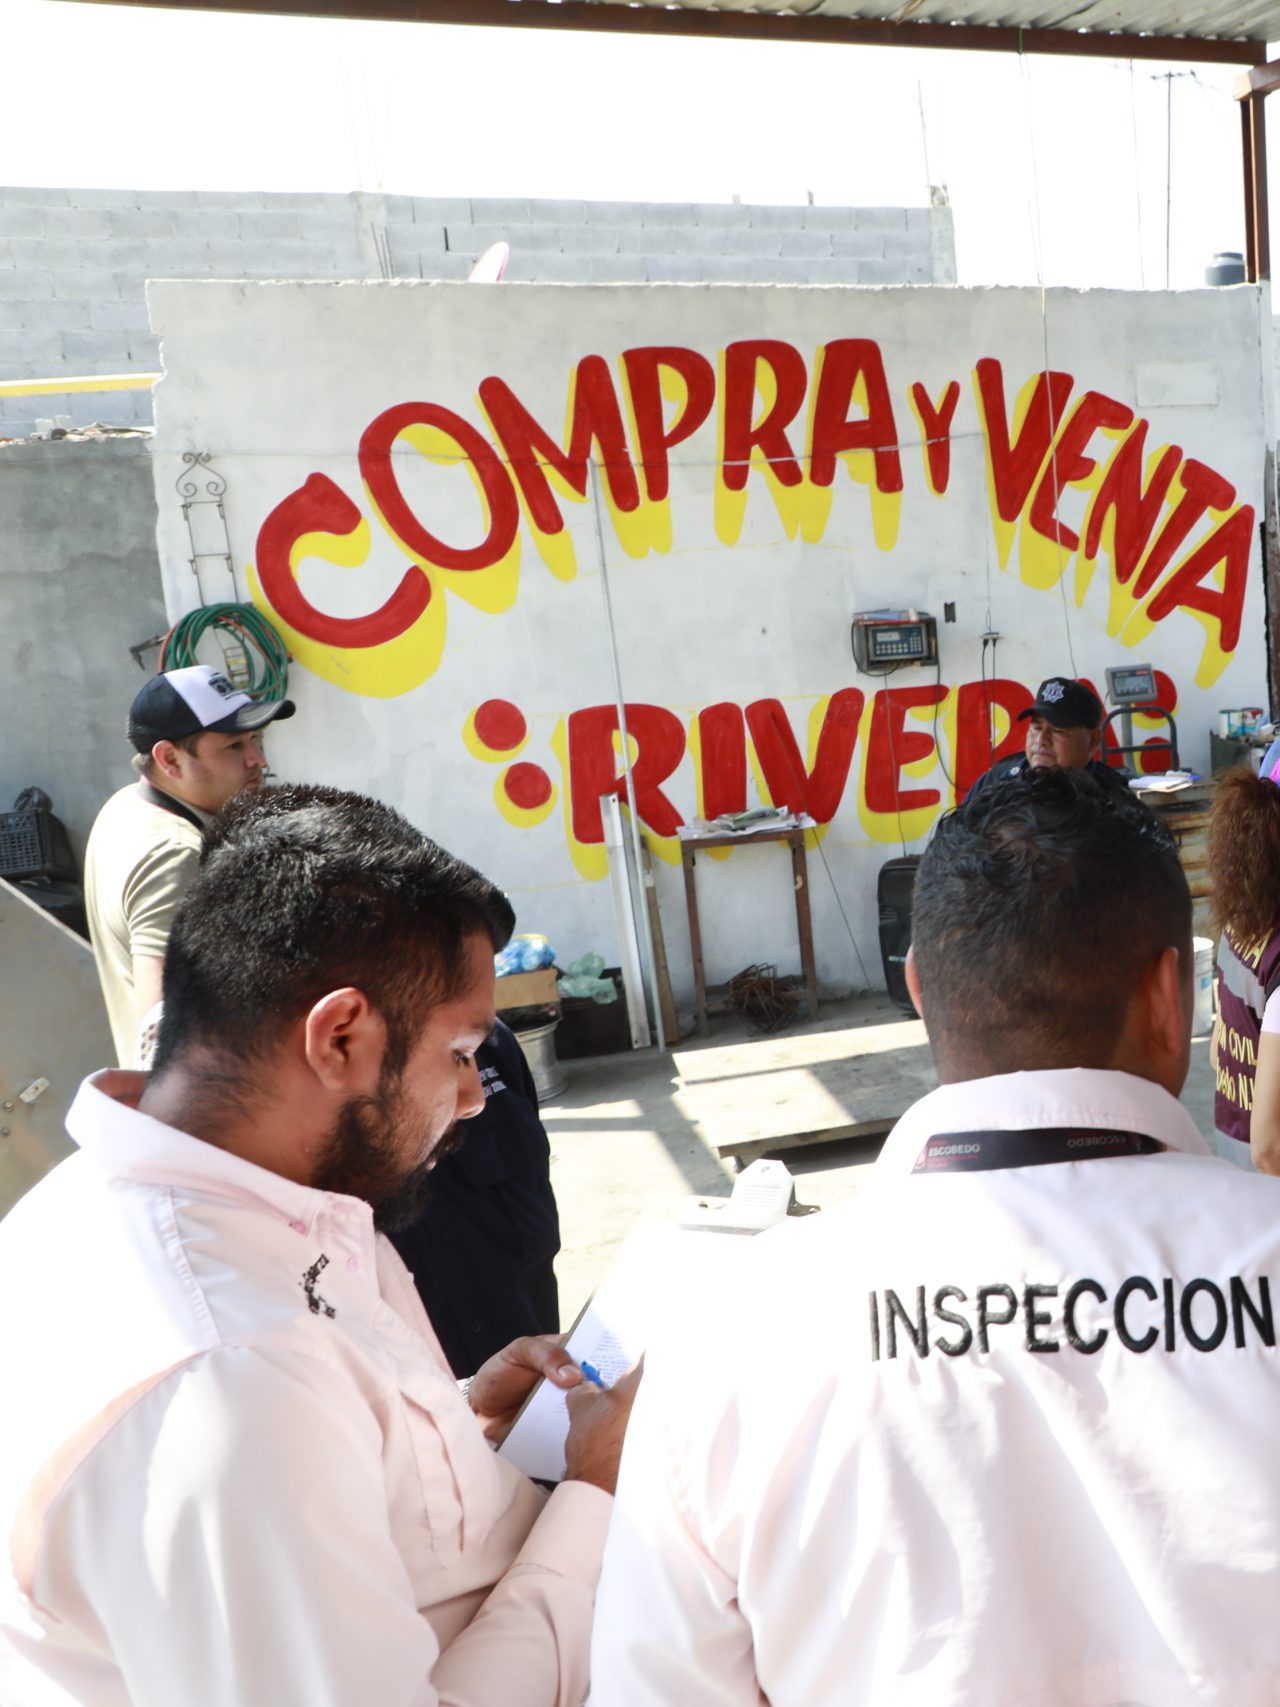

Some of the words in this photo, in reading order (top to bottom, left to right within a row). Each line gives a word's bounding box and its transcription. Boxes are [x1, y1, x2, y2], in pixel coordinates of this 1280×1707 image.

[254, 338, 903, 650] COMPRA
[911, 380, 960, 494] Y
[975, 357, 1255, 653] VENTA
[1229, 1027, 1257, 1067] CIVIL
[928, 1144, 981, 1157] ESCOBEDO
[868, 1275, 1277, 1363] INSPECCION
